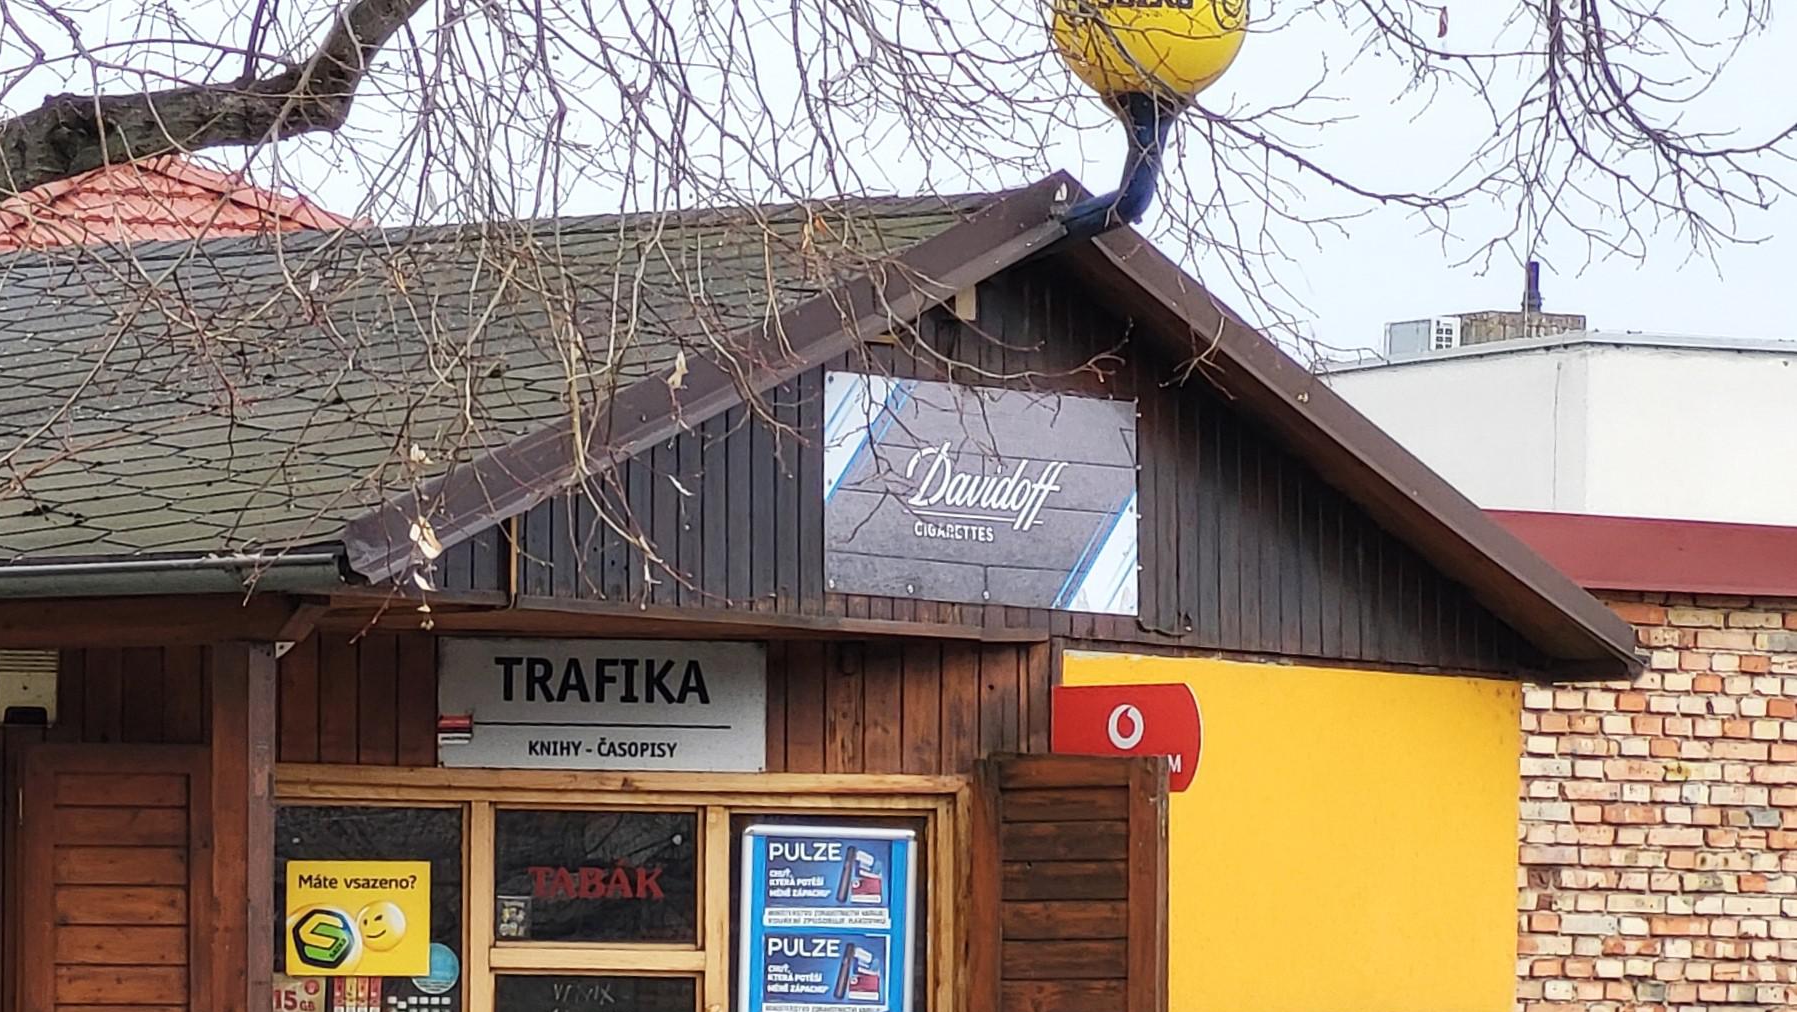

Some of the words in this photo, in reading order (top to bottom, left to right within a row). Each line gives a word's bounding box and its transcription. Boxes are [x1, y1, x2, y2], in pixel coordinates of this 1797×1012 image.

[906, 440, 1069, 531] Davidoff
[913, 520, 994, 542] CIGARETTES
[494, 656, 710, 705] TRAFIKA
[528, 740, 582, 756] KNIHY
[597, 737, 677, 757] ČASOPISY
[769, 842, 843, 862] PULZE
[298, 874, 338, 889] Máte
[344, 874, 417, 890] vsazeno?
[528, 857, 665, 900] TABÁK
[767, 937, 841, 957] PULZE
[273, 990, 297, 1011] 15
